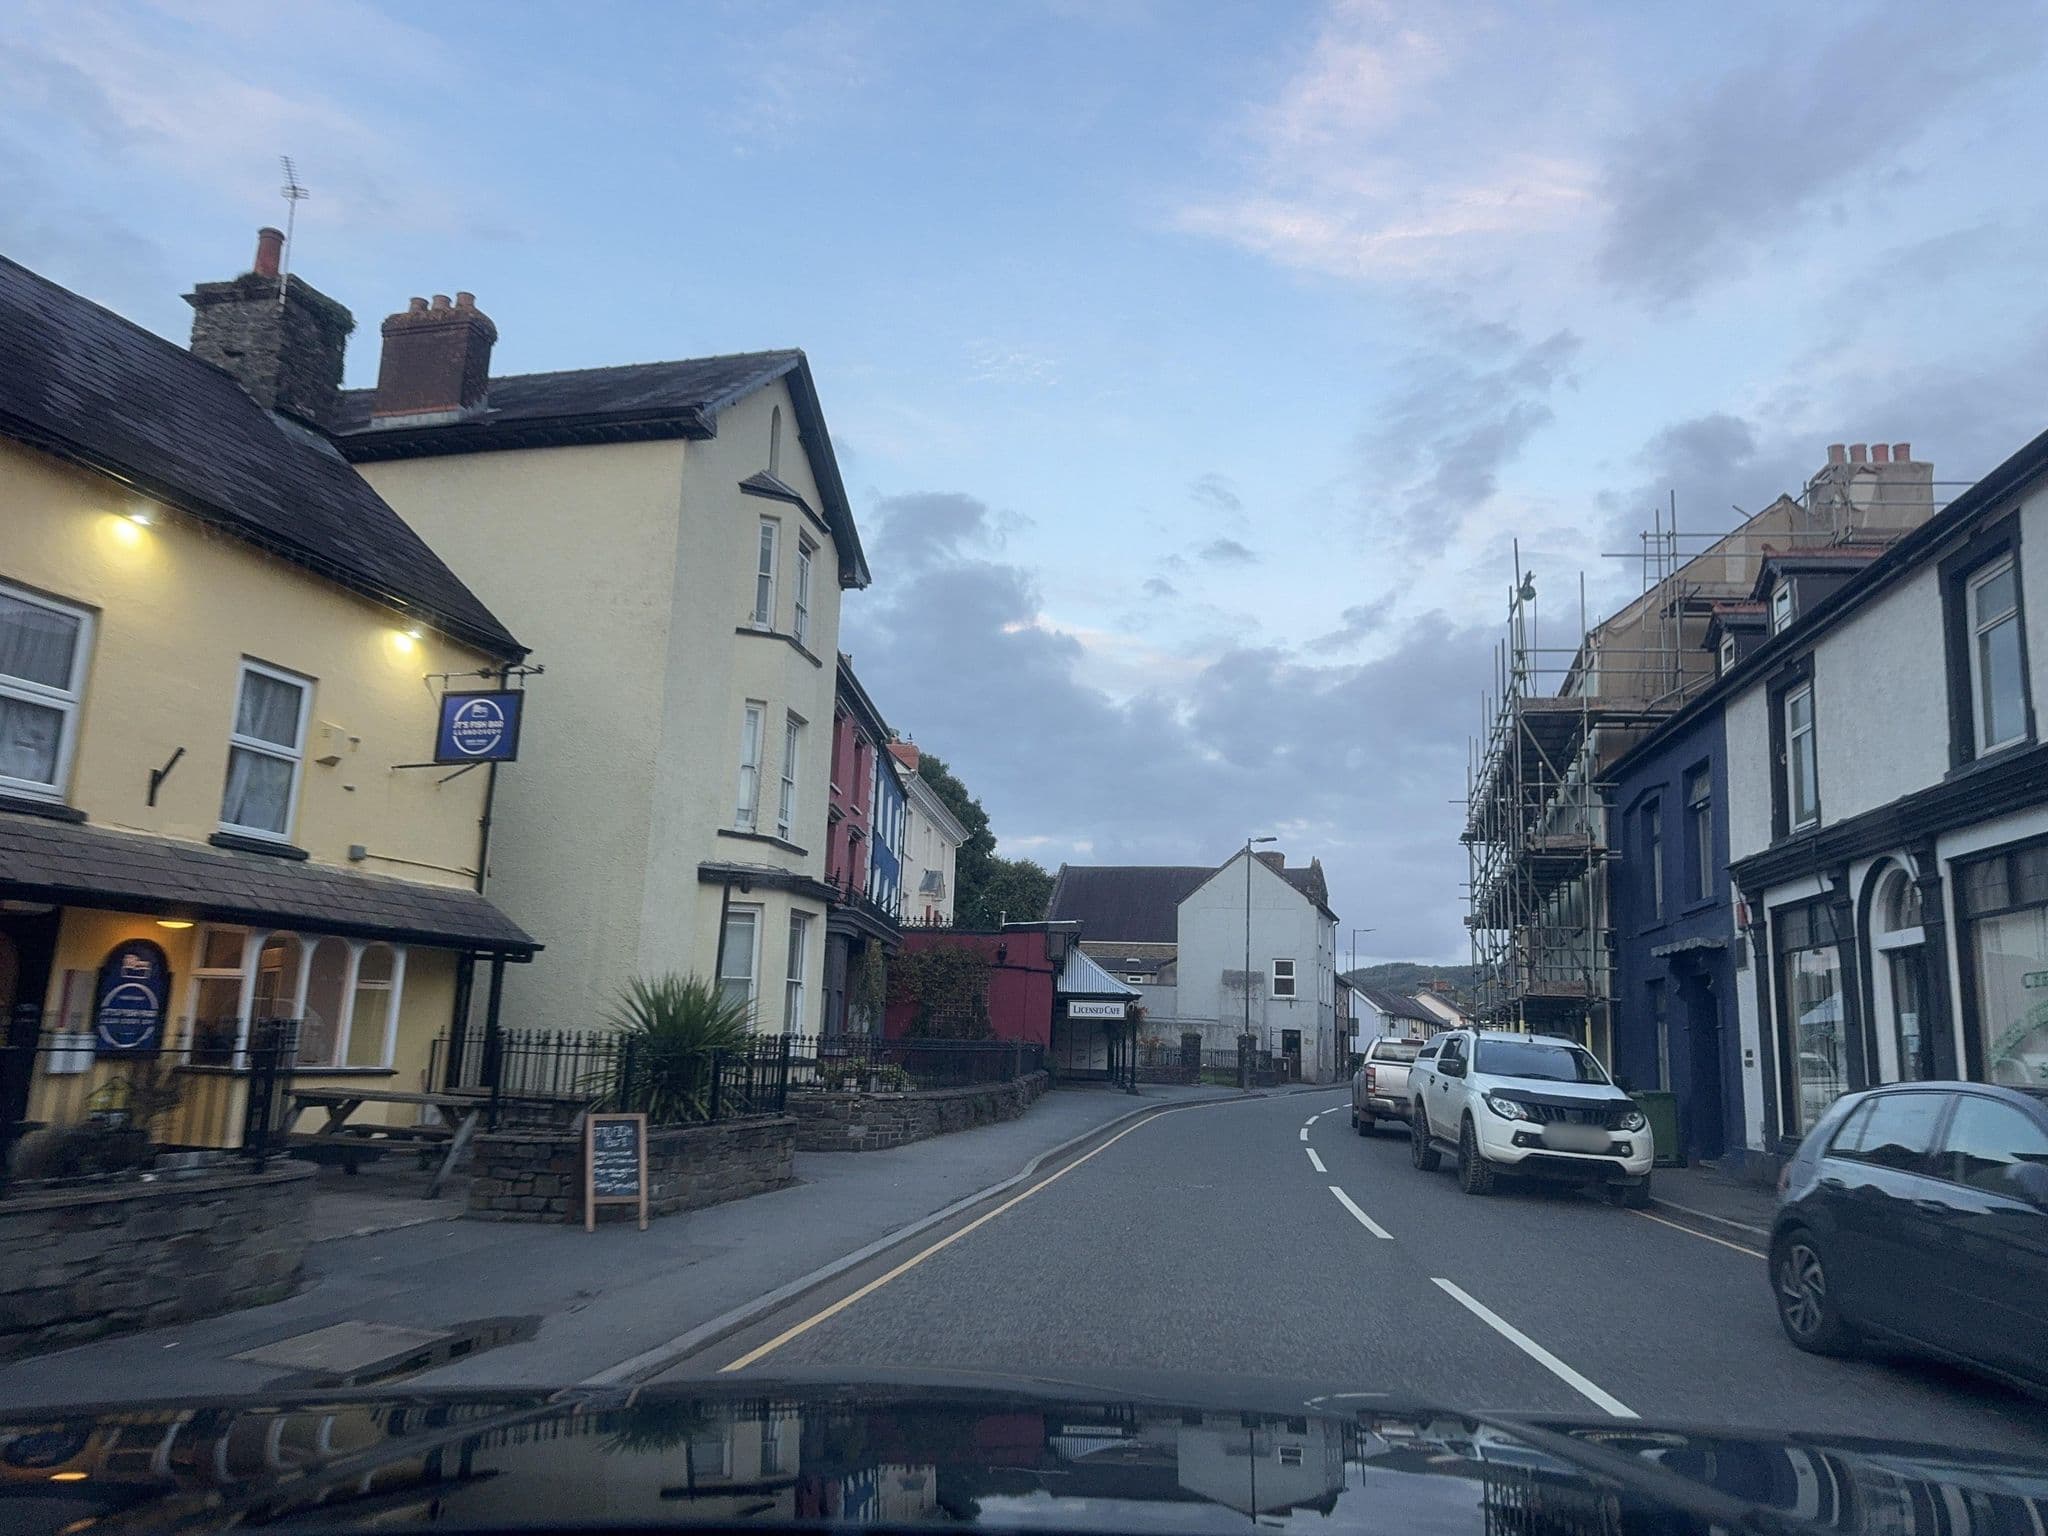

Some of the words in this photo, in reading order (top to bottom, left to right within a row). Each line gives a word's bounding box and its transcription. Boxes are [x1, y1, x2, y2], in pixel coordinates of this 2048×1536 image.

[470, 720, 487, 728] FISH
[487, 720, 504, 728] BAR
[1073, 1005, 1104, 1014] LICENSED
